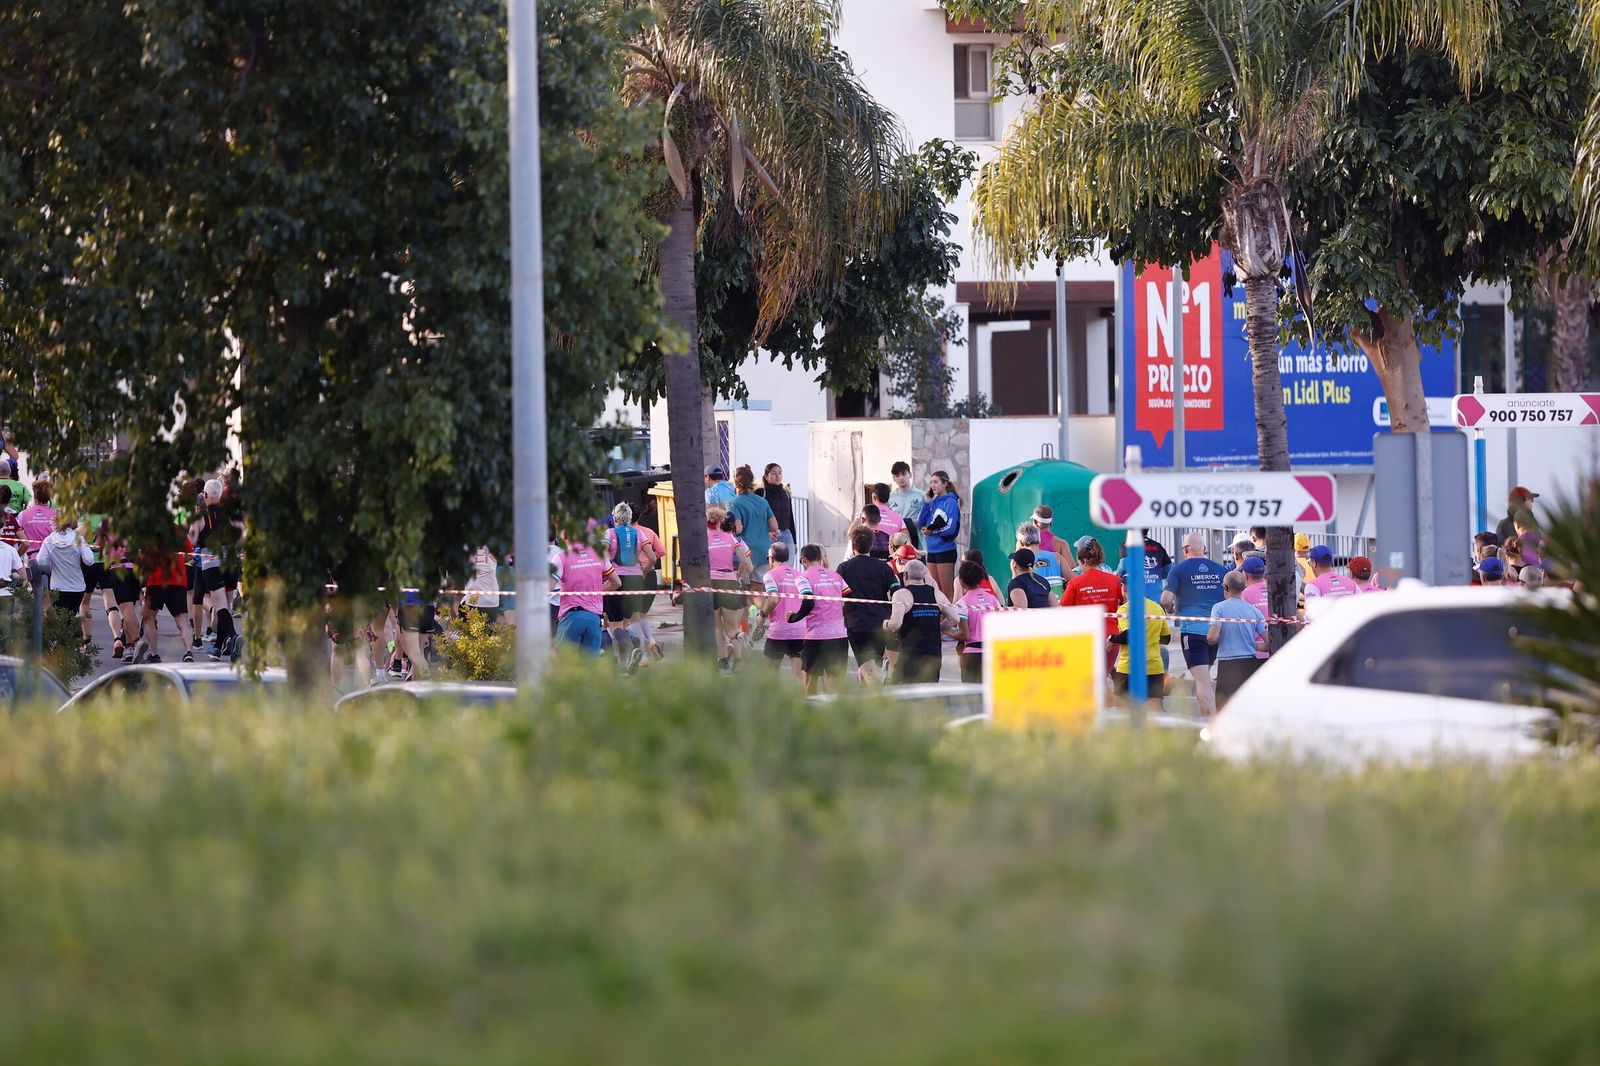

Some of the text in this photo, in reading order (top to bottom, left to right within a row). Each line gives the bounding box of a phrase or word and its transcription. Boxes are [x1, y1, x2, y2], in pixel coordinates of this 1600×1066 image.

[1278, 350, 1293, 373] ún
[1296, 350, 1322, 373] más
[1147, 364, 1212, 393] PRCIO
[1294, 379, 1320, 405] Lidl
[1322, 379, 1351, 405] Plus
[1489, 409, 1573, 422] 900 750 757
[1150, 500, 1283, 517] 900 750 757
